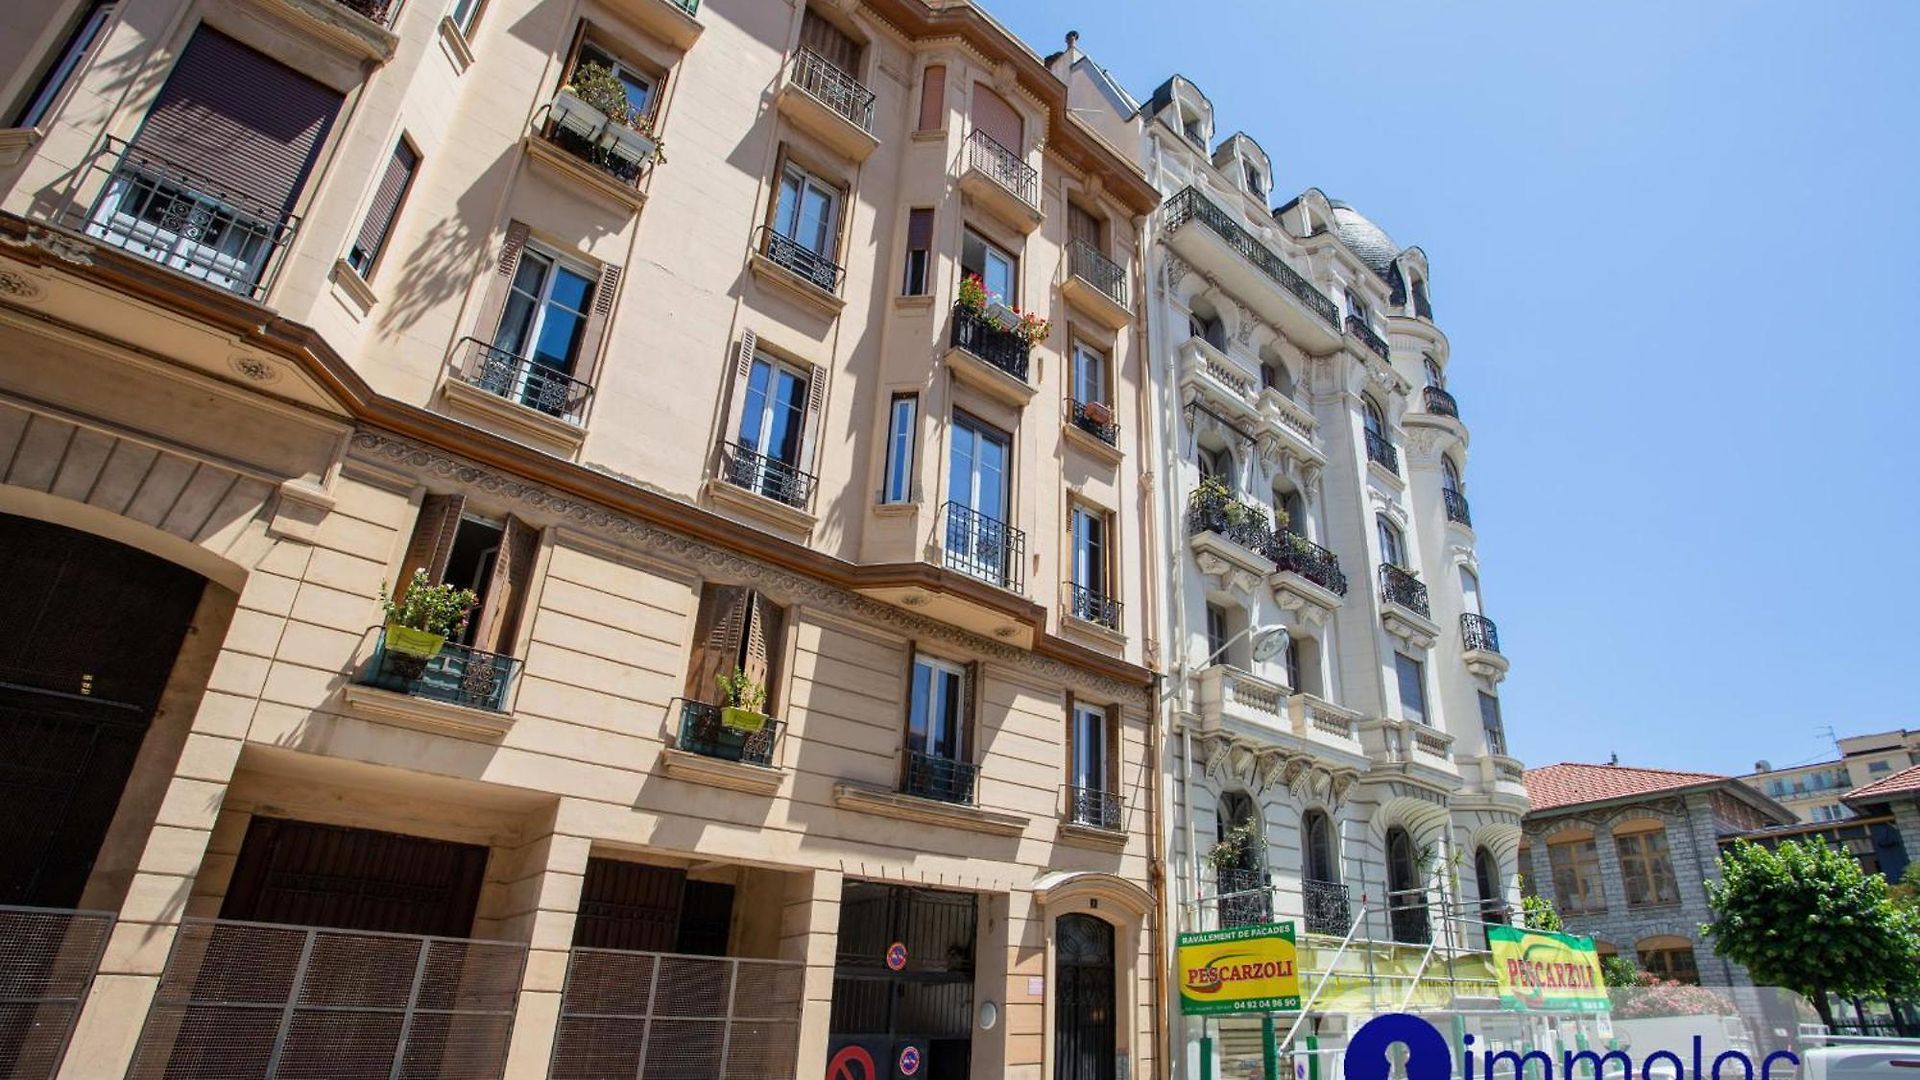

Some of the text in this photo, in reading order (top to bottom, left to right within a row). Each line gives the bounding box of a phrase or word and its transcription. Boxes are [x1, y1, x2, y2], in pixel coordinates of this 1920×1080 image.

[1182, 932, 1235, 944] RAVALEMENT
[1238, 930, 1249, 938] DE
[1188, 961, 1292, 984] PESCARZOLI
[1234, 1001, 1245, 1009] 04
[1259, 1000, 1270, 1008] 04
